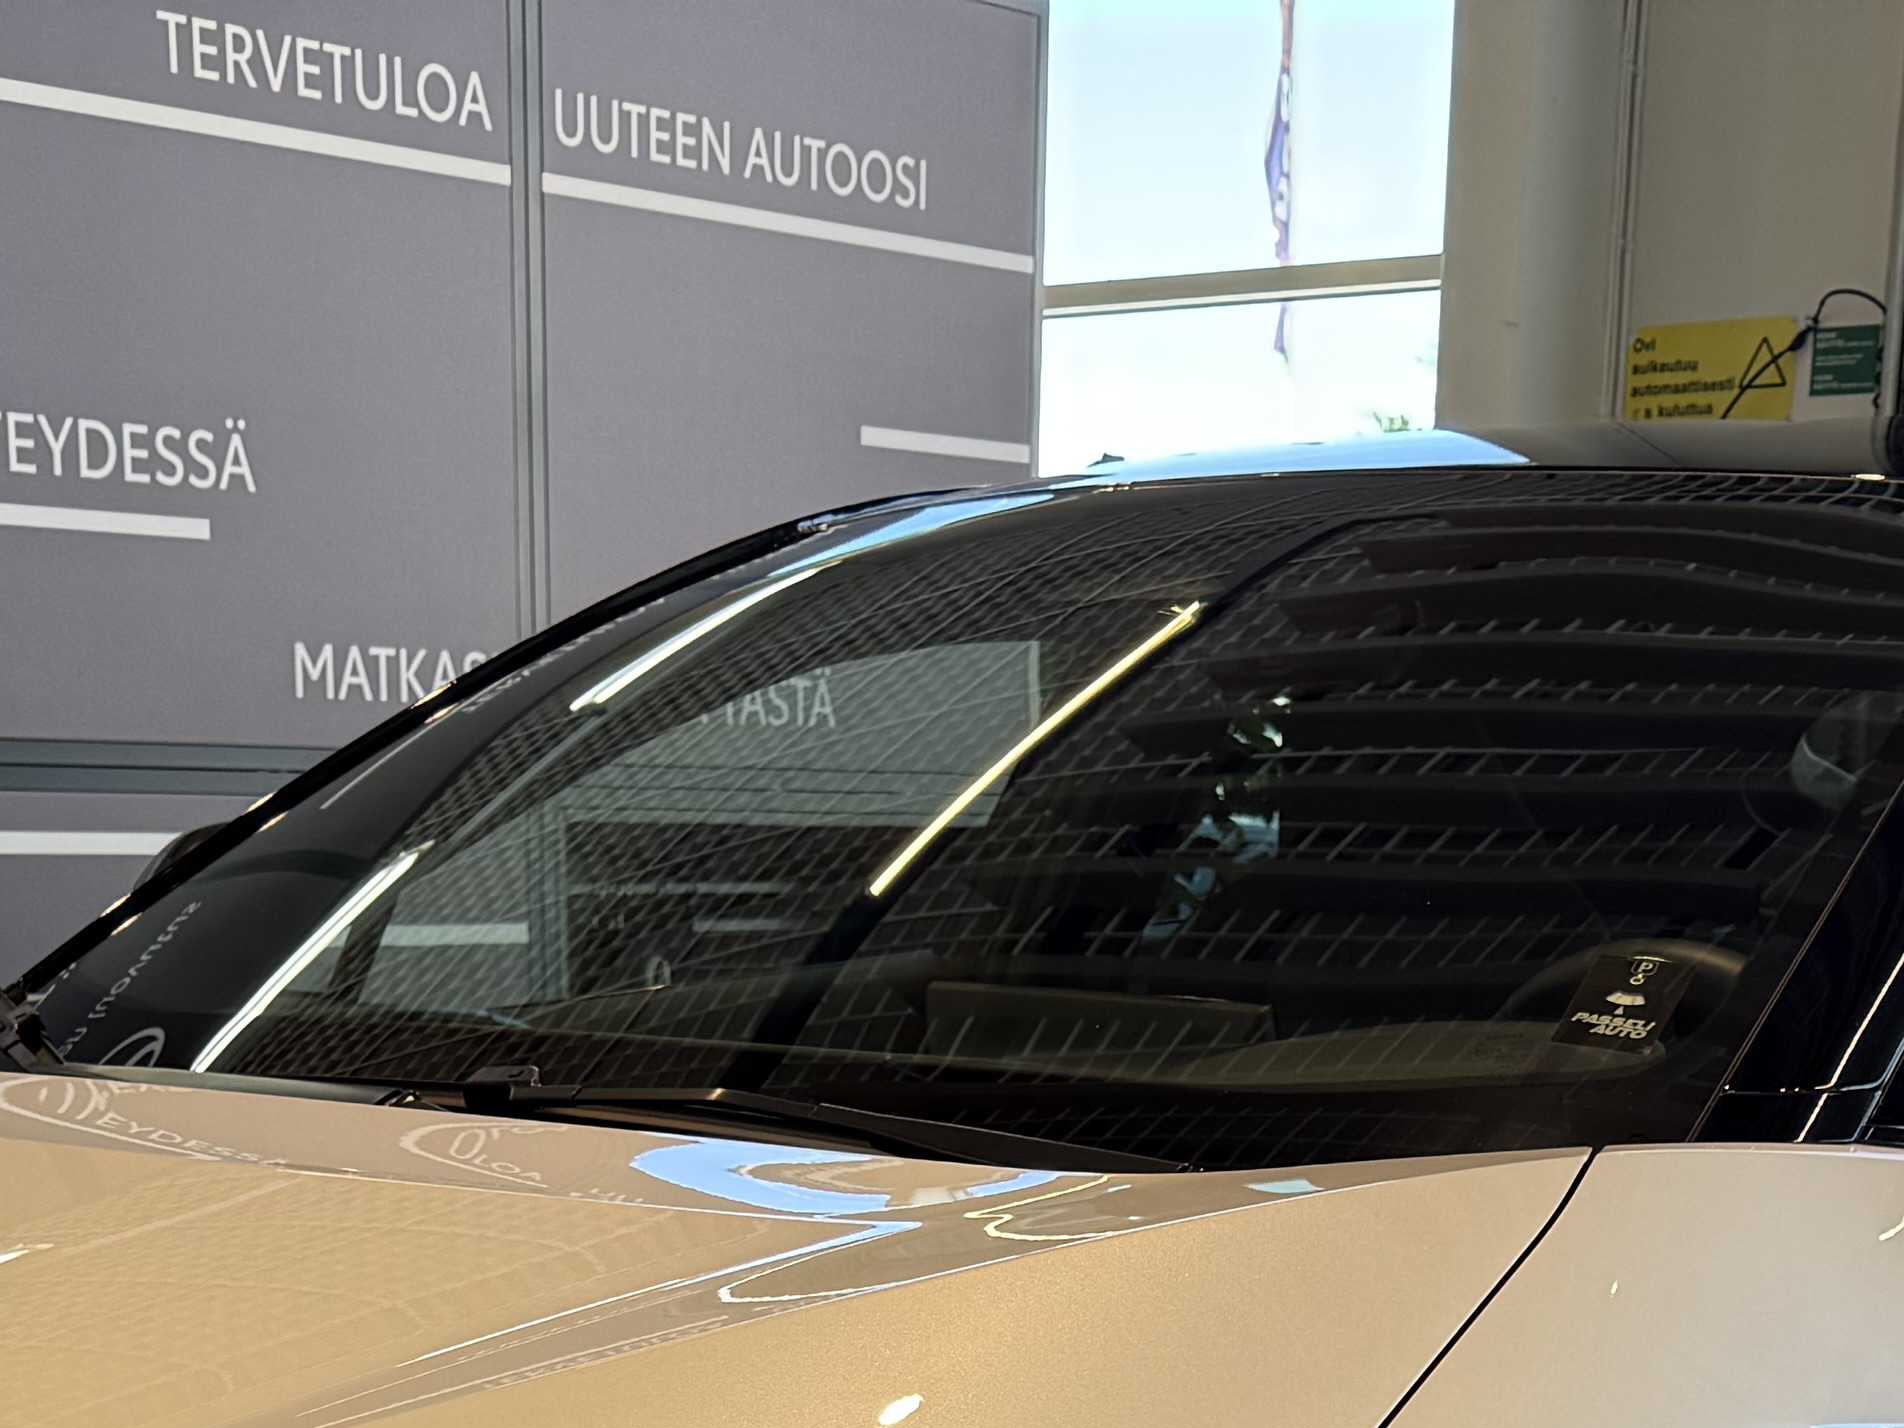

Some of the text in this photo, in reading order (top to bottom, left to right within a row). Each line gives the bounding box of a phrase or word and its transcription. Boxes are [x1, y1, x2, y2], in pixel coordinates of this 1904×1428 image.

[156, 9, 928, 211] TERVETULOA UUTEEN AUTOOSI
[1571, 1012, 1656, 1031] PASSELI
[1589, 1025, 1648, 1039] AUTO
